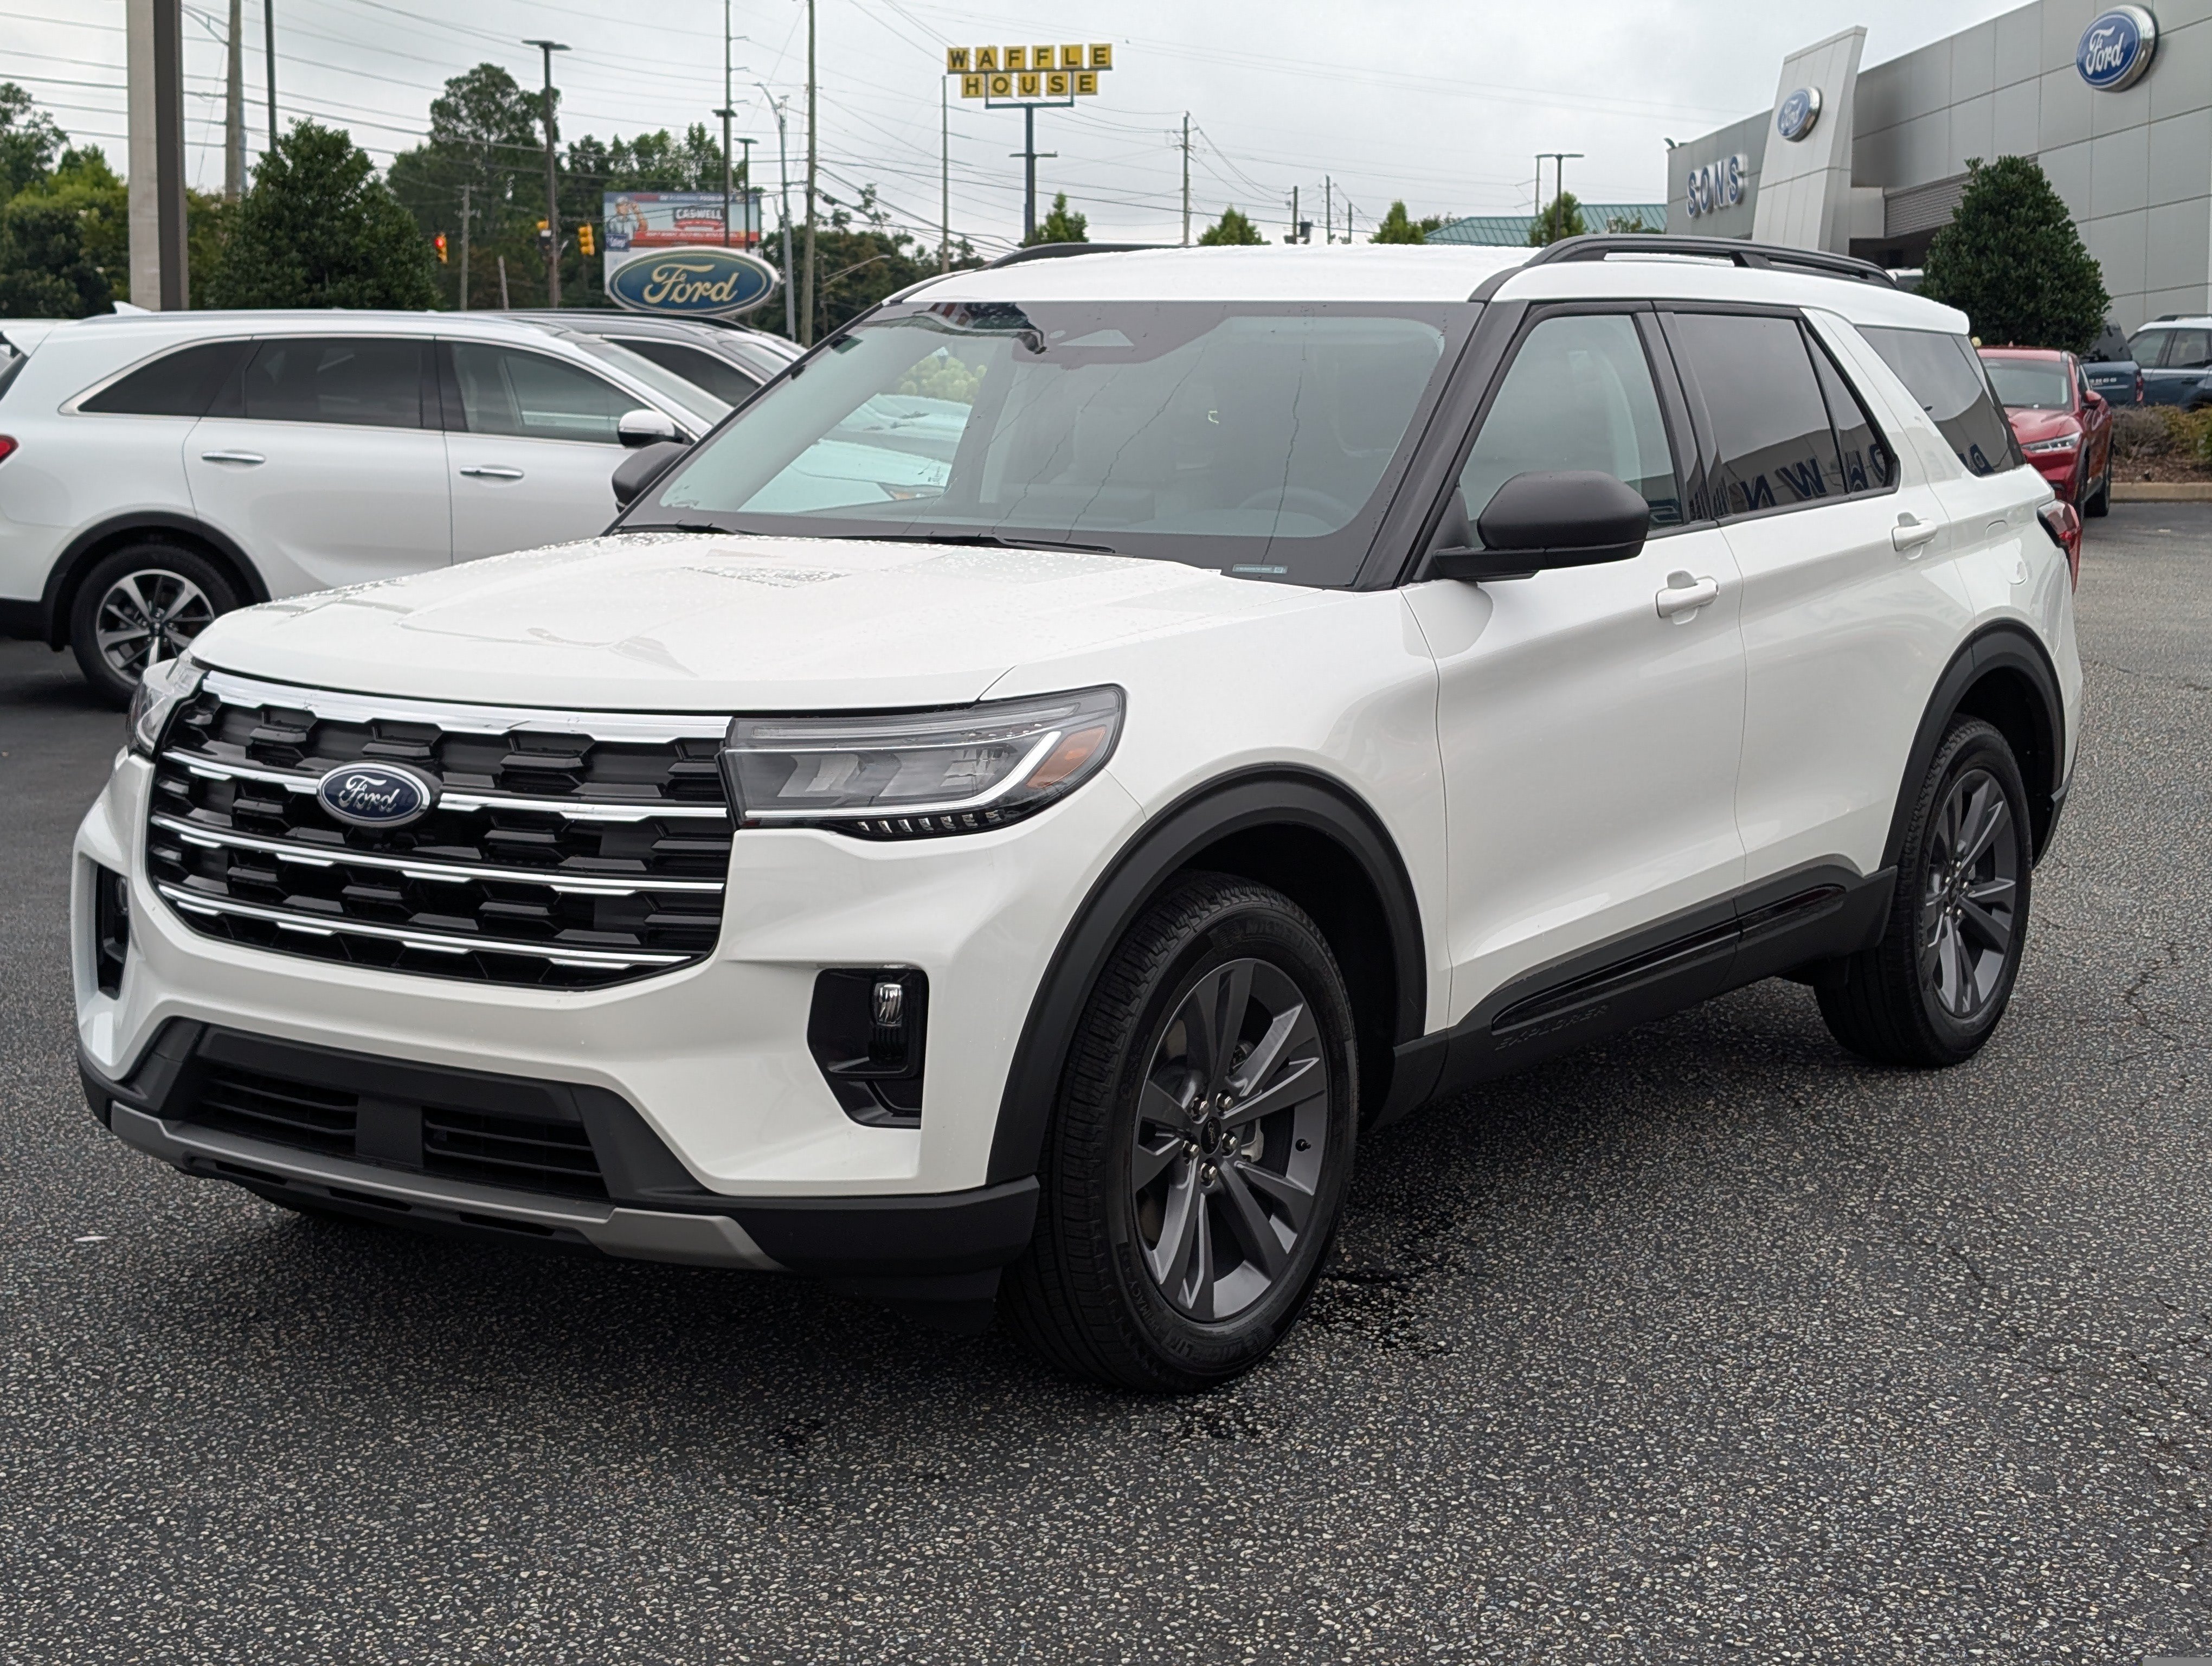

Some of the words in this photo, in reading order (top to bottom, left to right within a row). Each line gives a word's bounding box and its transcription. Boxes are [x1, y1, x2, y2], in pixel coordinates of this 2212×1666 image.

[950, 47, 1107, 68] WAFFLE
[2085, 25, 2125, 75] Ford
[965, 74, 1093, 94] HOUSE
[1781, 99, 1803, 128] Ford
[1687, 155, 1740, 217] SONS
[643, 264, 739, 303] Ford
[338, 774, 400, 813] Ford
